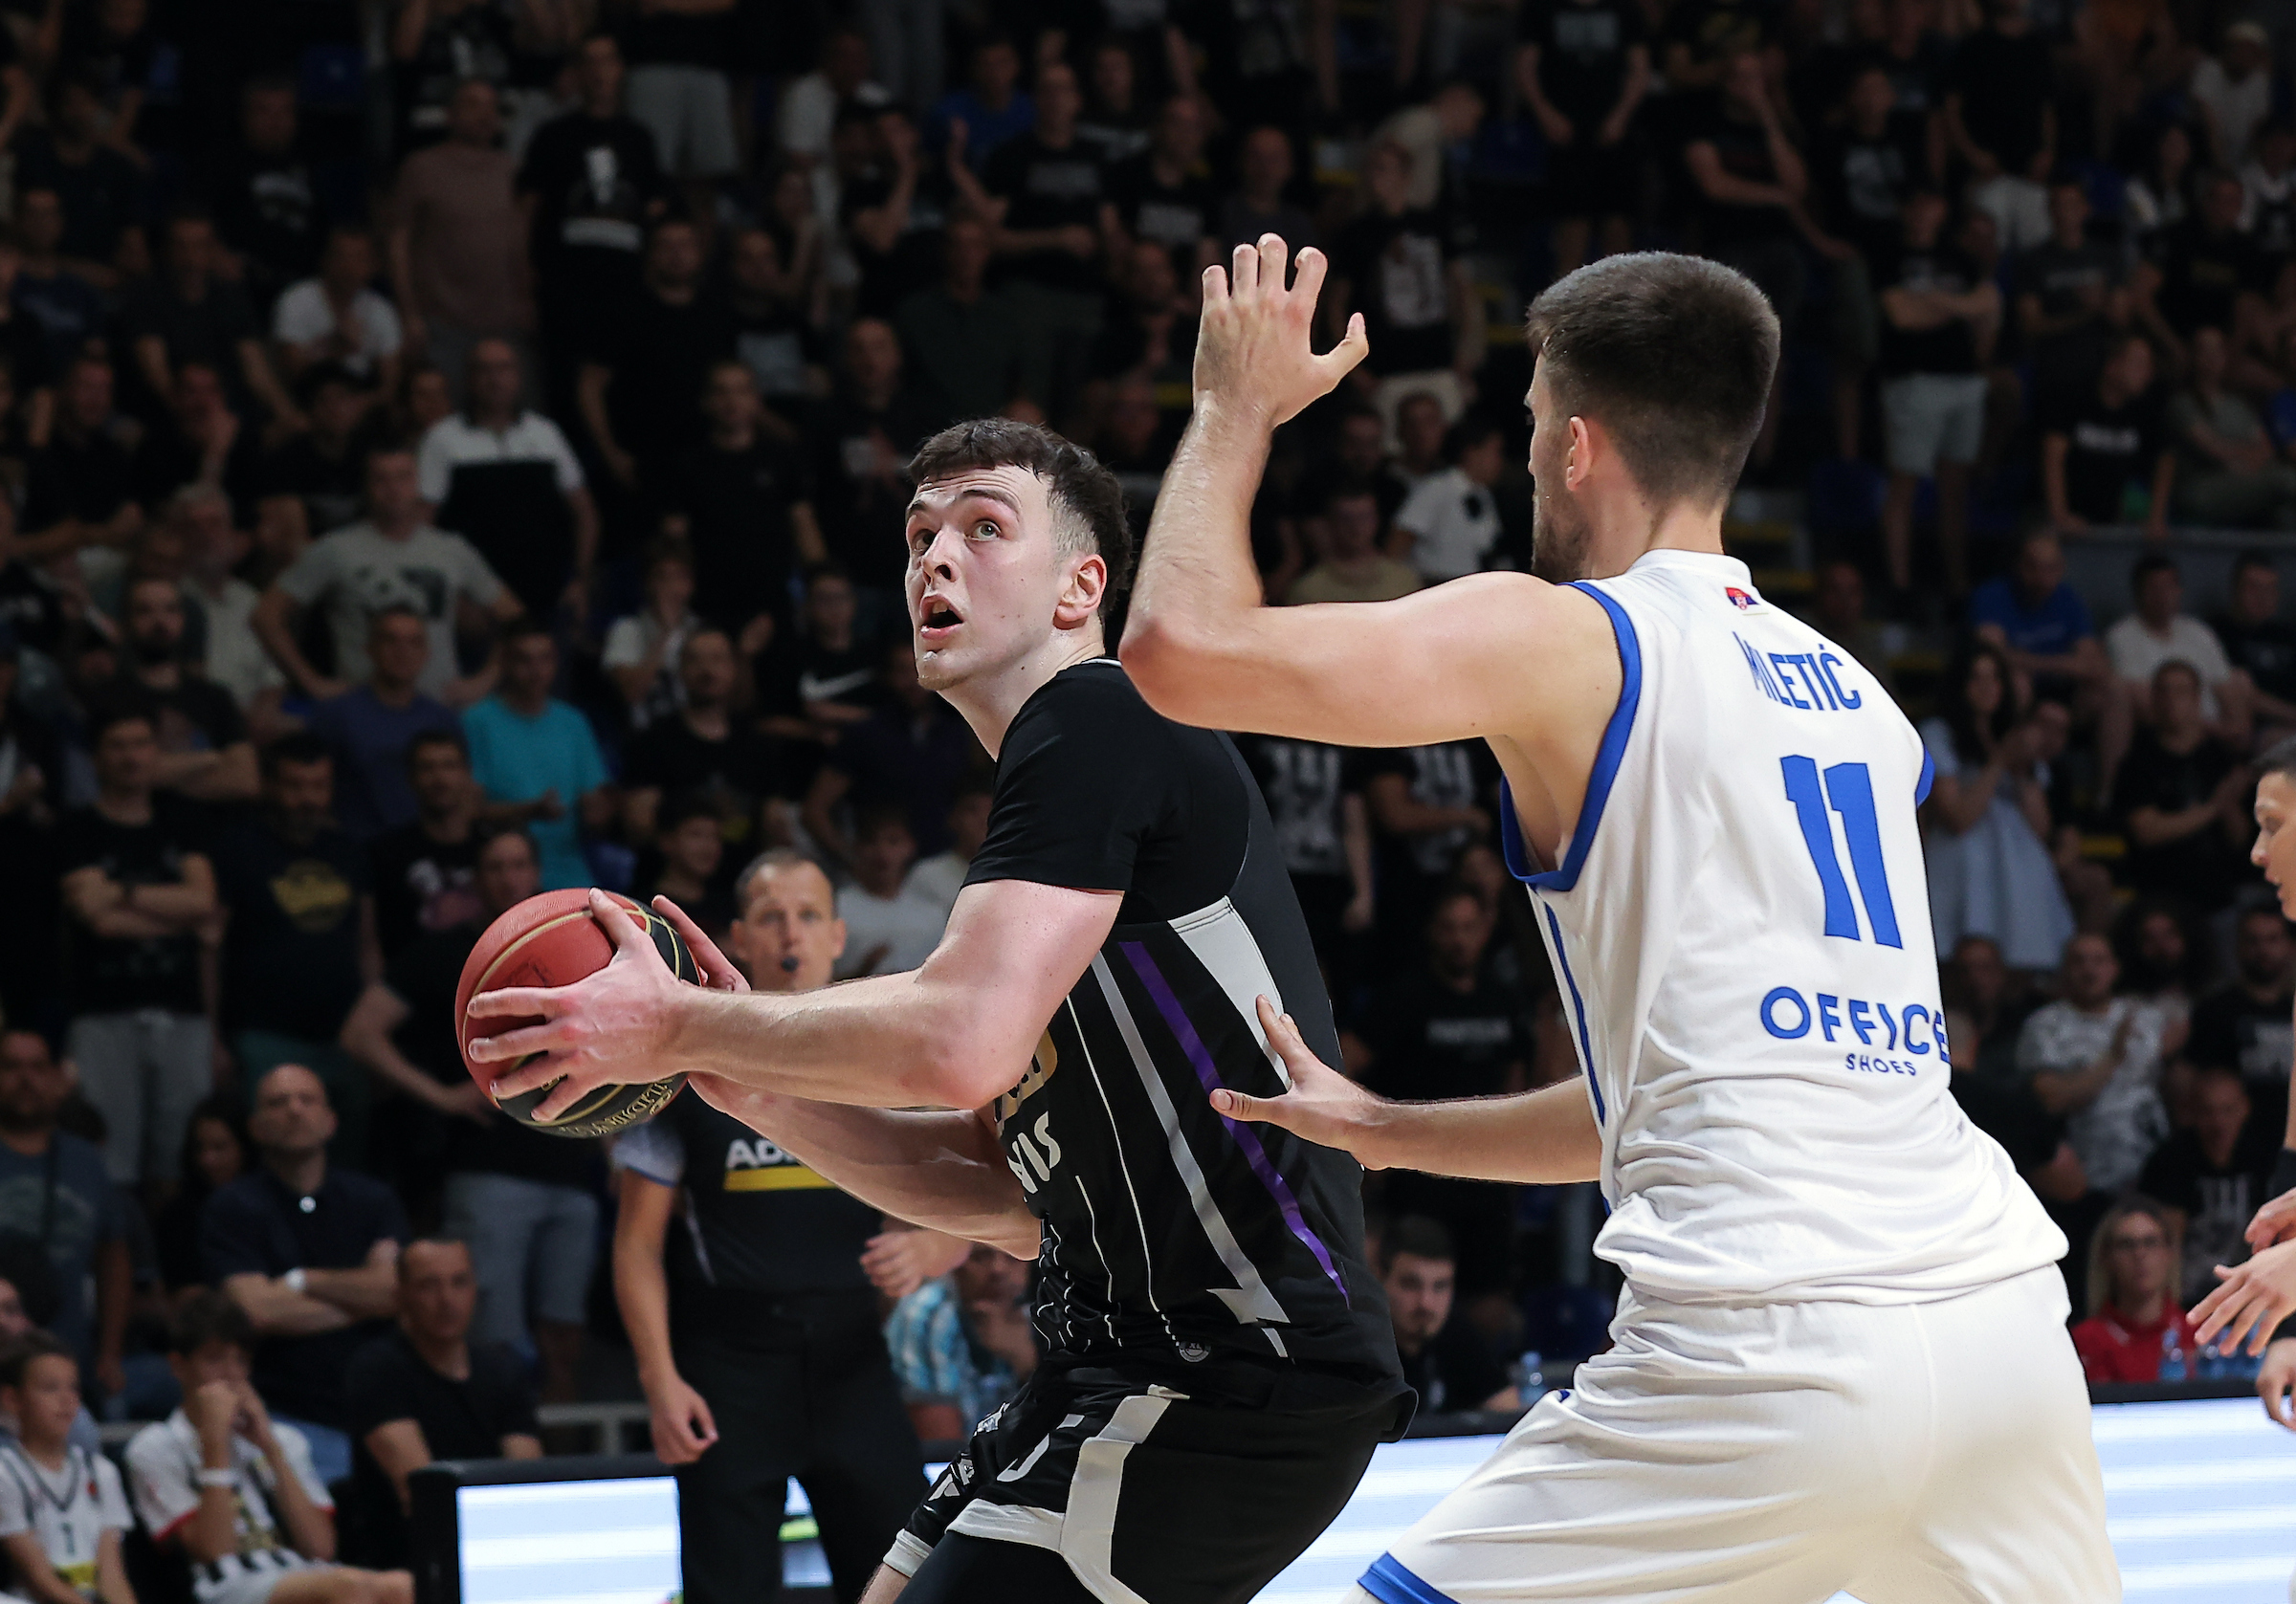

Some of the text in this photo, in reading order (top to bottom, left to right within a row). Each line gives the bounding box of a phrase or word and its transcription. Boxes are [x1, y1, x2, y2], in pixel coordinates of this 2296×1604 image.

[1779, 755, 1904, 950] 11
[1760, 986, 1951, 1064] OFFICE
[1845, 1053, 1916, 1076] SHOES
